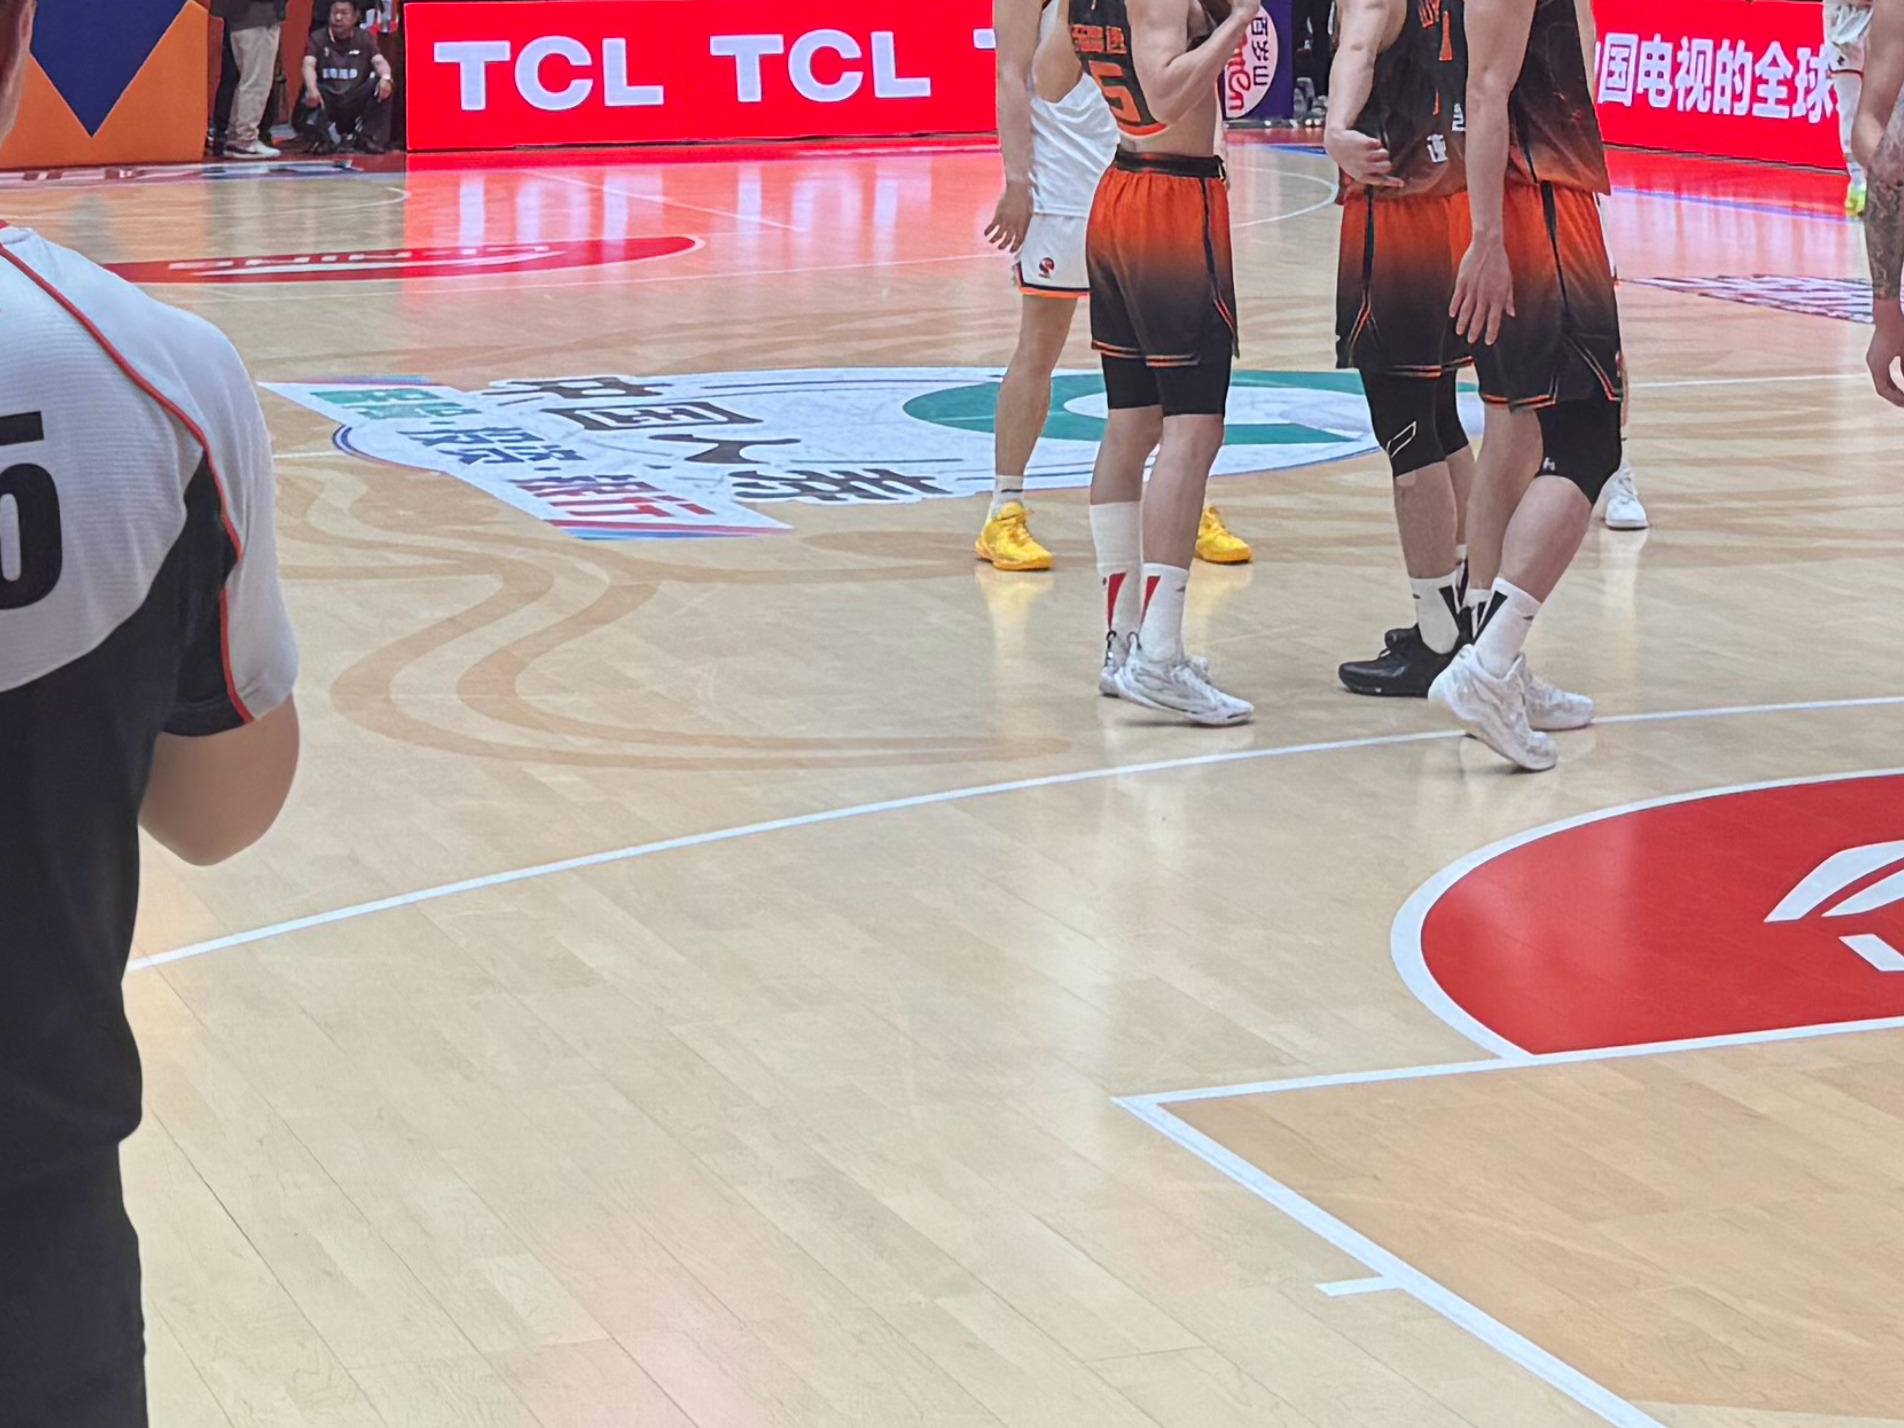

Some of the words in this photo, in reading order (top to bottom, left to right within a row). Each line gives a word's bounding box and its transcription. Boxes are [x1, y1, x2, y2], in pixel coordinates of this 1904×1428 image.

[434, 34, 666, 112] TCL
[709, 26, 932, 103] TCL
[1595, 31, 1839, 125] 国电视的全球
